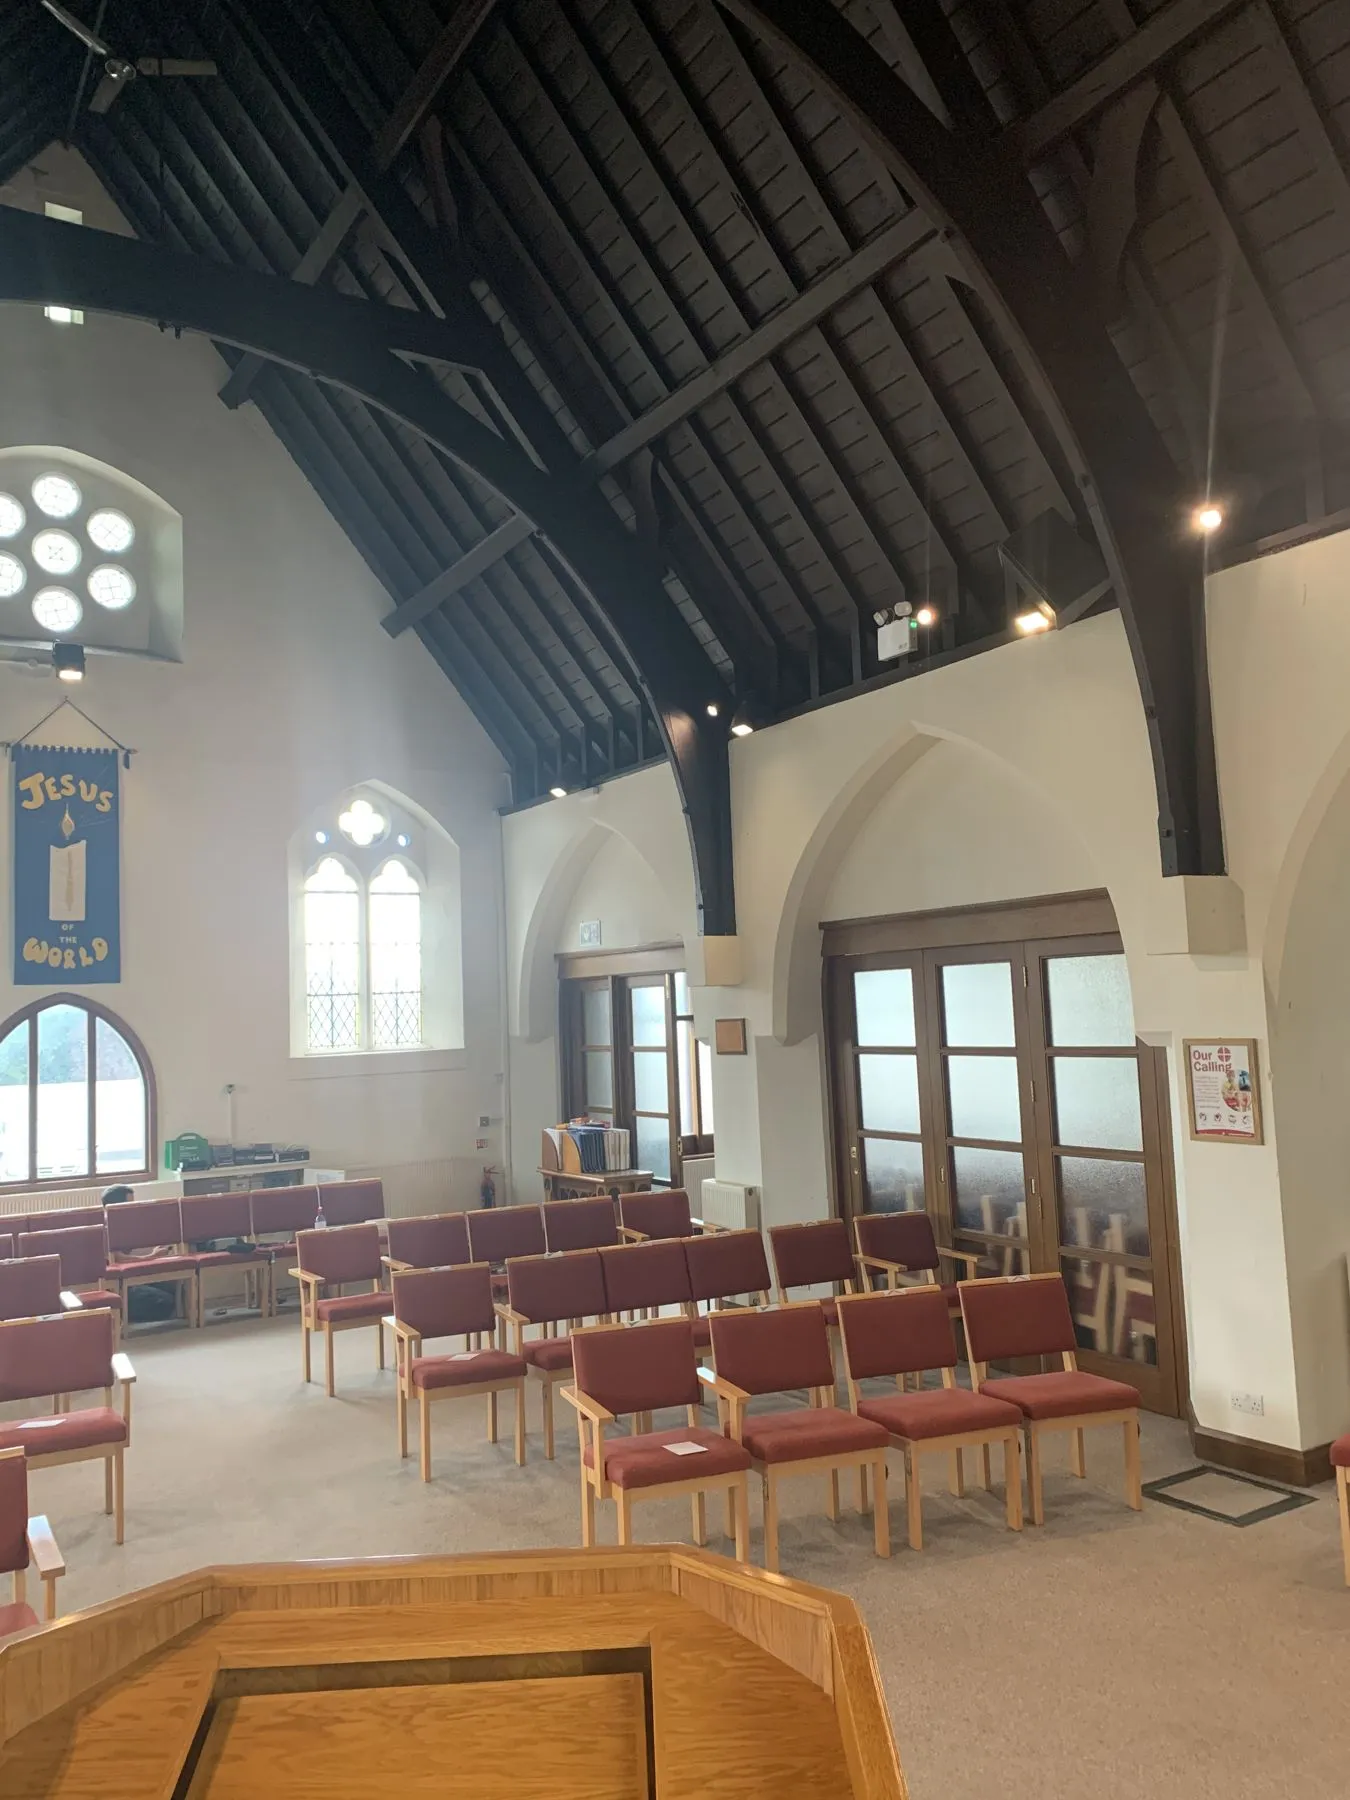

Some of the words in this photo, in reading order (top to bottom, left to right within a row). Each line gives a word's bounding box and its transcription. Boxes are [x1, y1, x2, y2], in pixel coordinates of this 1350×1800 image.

[19, 772, 113, 812] JESUS
[61, 923, 75, 931] OF
[59, 936, 78, 944] THE
[23, 937, 108, 969] WORLD
[1193, 1050, 1212, 1060] Our
[1194, 1061, 1232, 1073] Calling
